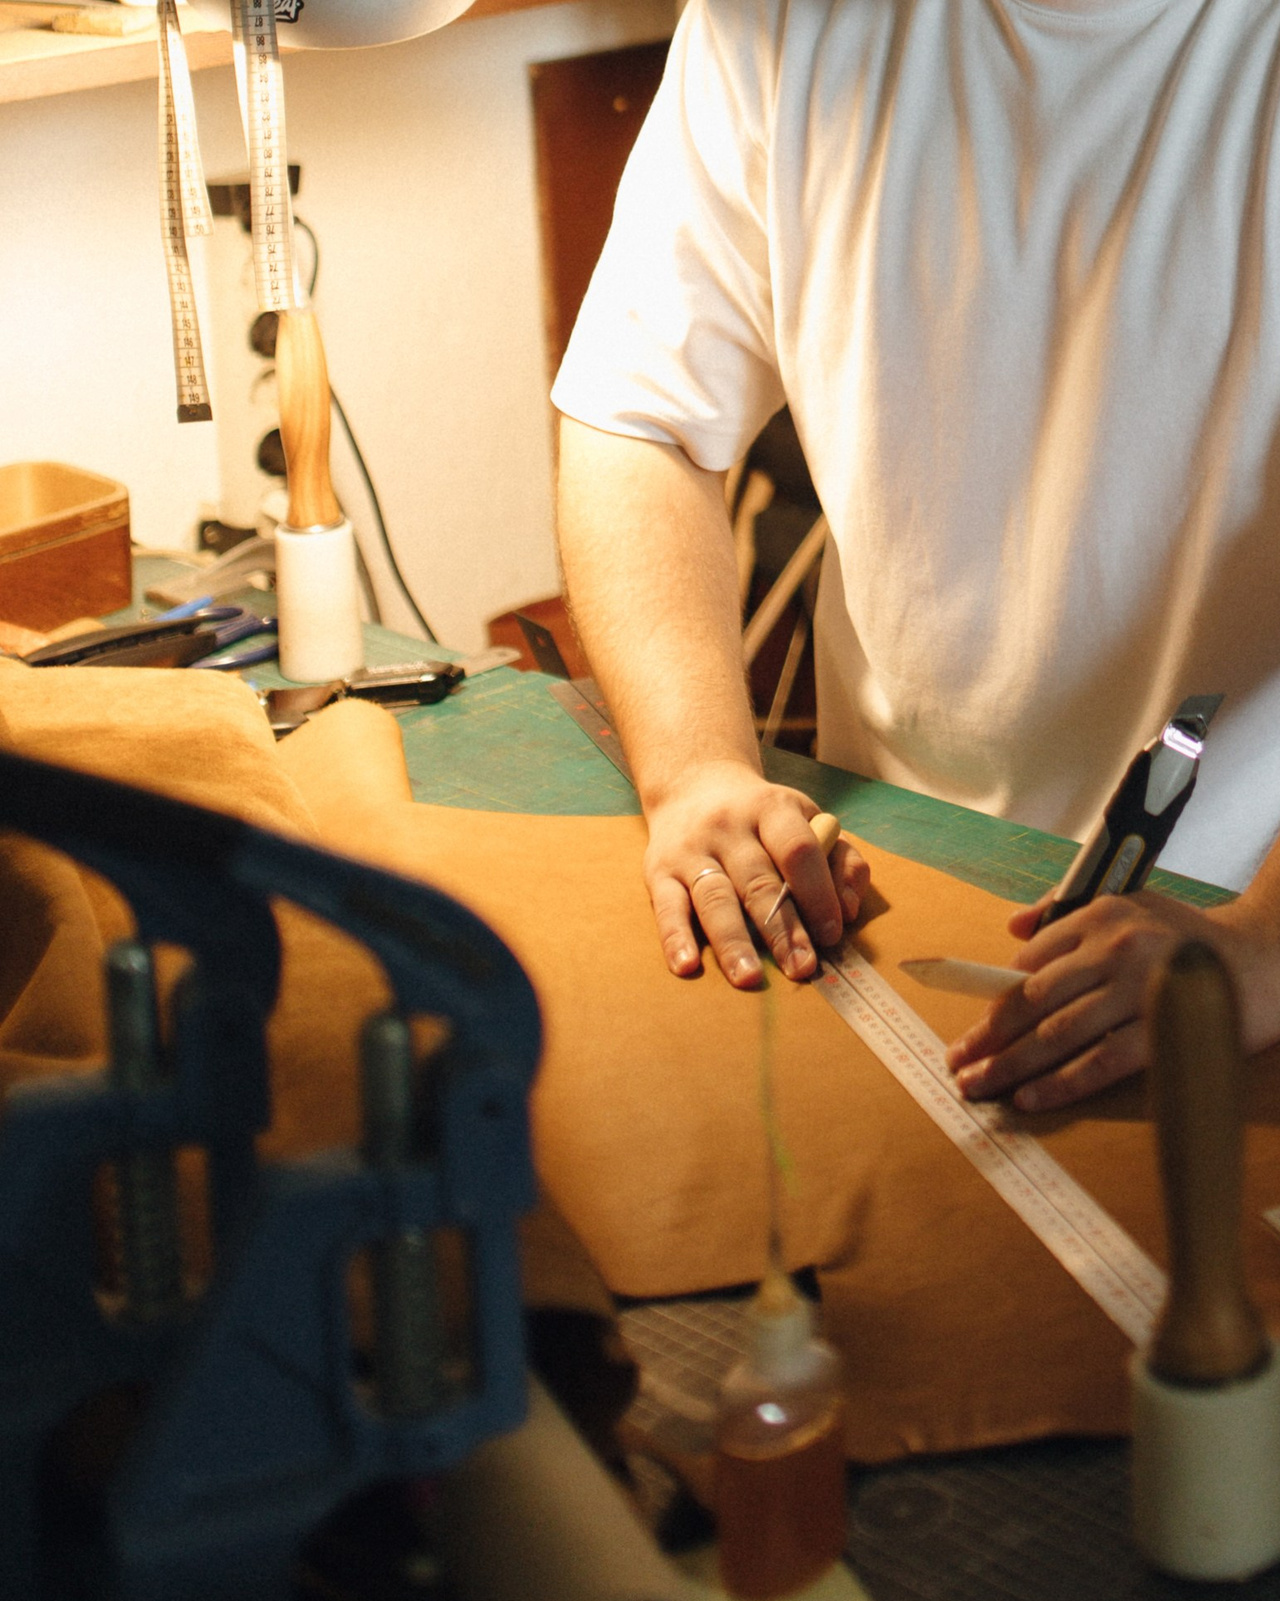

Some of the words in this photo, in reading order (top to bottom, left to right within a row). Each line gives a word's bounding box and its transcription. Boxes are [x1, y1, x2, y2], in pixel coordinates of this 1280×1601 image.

[255, 17, 263, 27] 87
[256, 35, 265, 46] 86
[183, 338, 194, 348] 146
[184, 356, 195, 367] 147
[186, 375, 197, 385] 148
[188, 393, 200, 404] 149
